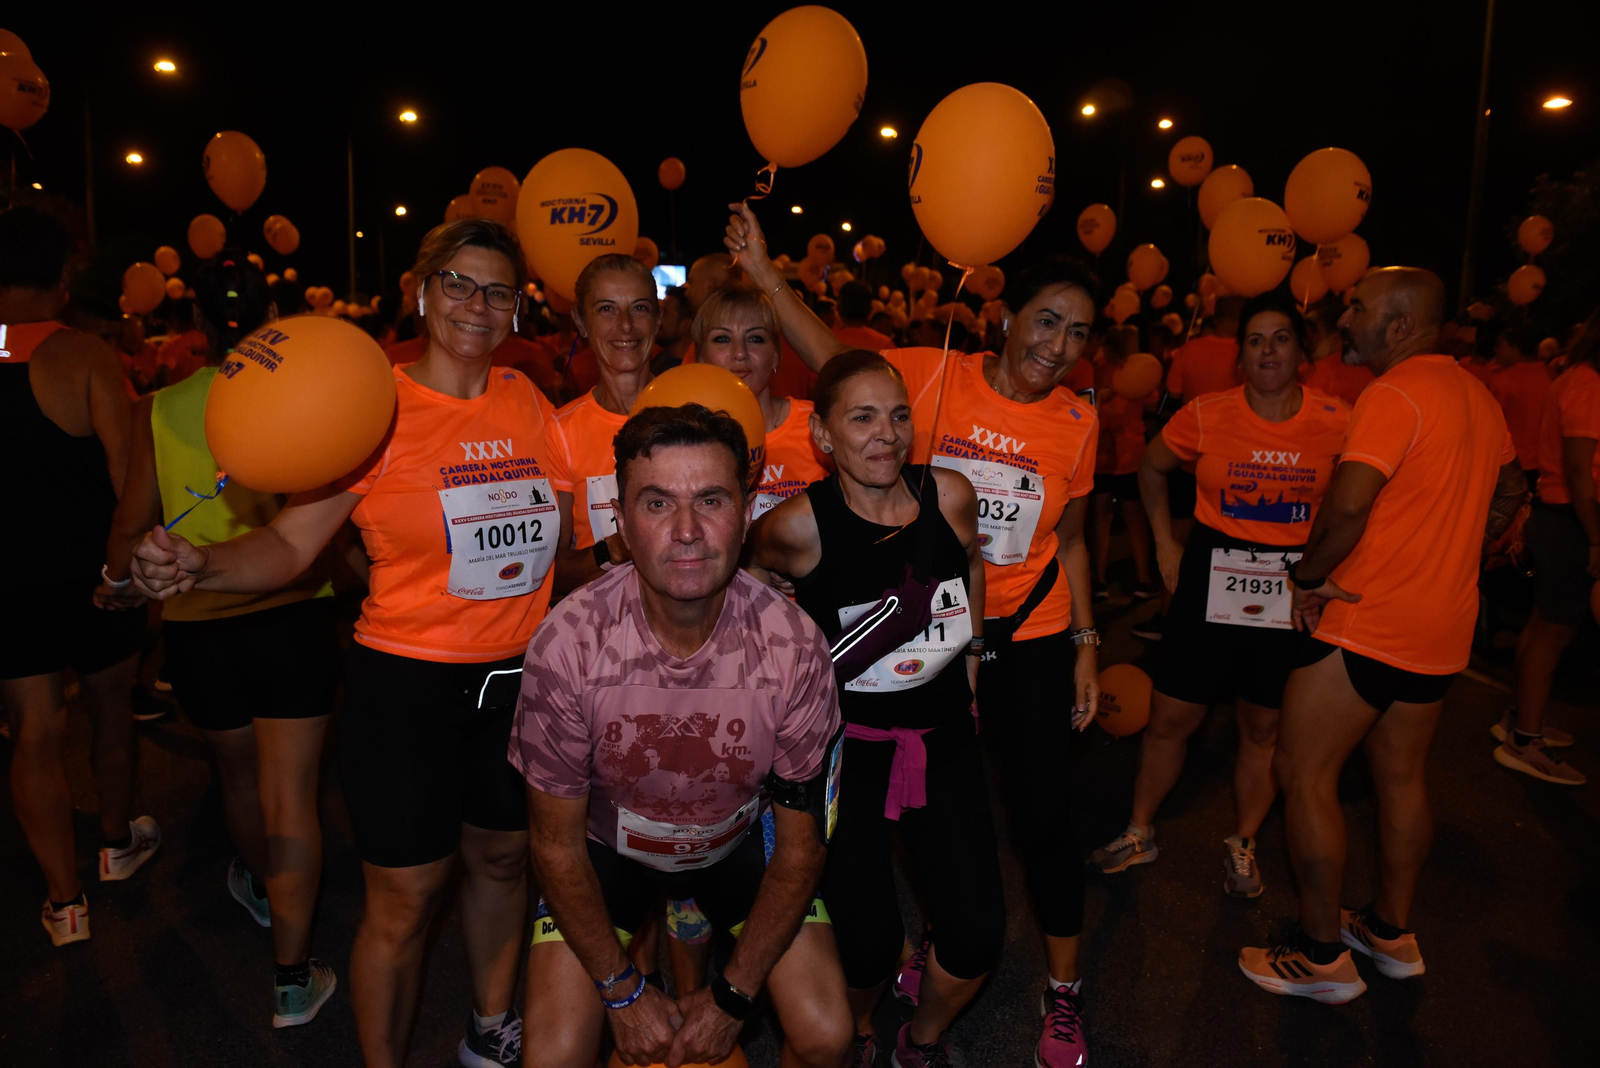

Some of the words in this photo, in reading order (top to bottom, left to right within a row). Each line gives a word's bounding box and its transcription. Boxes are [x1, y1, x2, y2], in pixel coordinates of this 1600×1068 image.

[540, 198, 586, 208] NOCTURNA
[579, 237, 616, 246] SEVILLA
[942, 434, 985, 454] CARRERA
[967, 424, 1027, 454] XXXV
[459, 438, 513, 461] XXXV
[1250, 450, 1301, 466] XXXV
[440, 463, 488, 475] CARRERA
[491, 457, 538, 470] NOCTURNA
[1228, 462, 1267, 471] CARRERA
[1271, 466, 1317, 475] NOCTURNA
[452, 466, 542, 486] GUADALQUIVIR
[1233, 469, 1316, 483] GUADALQUIVIR
[758, 480, 807, 491] NOCTURNA
[977, 498, 1020, 522] 032
[474, 519, 543, 551] 10012
[486, 554, 494, 562] DEL
[495, 552, 507, 560] MAR
[507, 549, 528, 558] TRUJILLO
[1225, 576, 1283, 595] 21931
[604, 721, 623, 743] 8
[726, 718, 746, 743] 9
[721, 742, 751, 756] km.
[673, 841, 711, 854] 92
